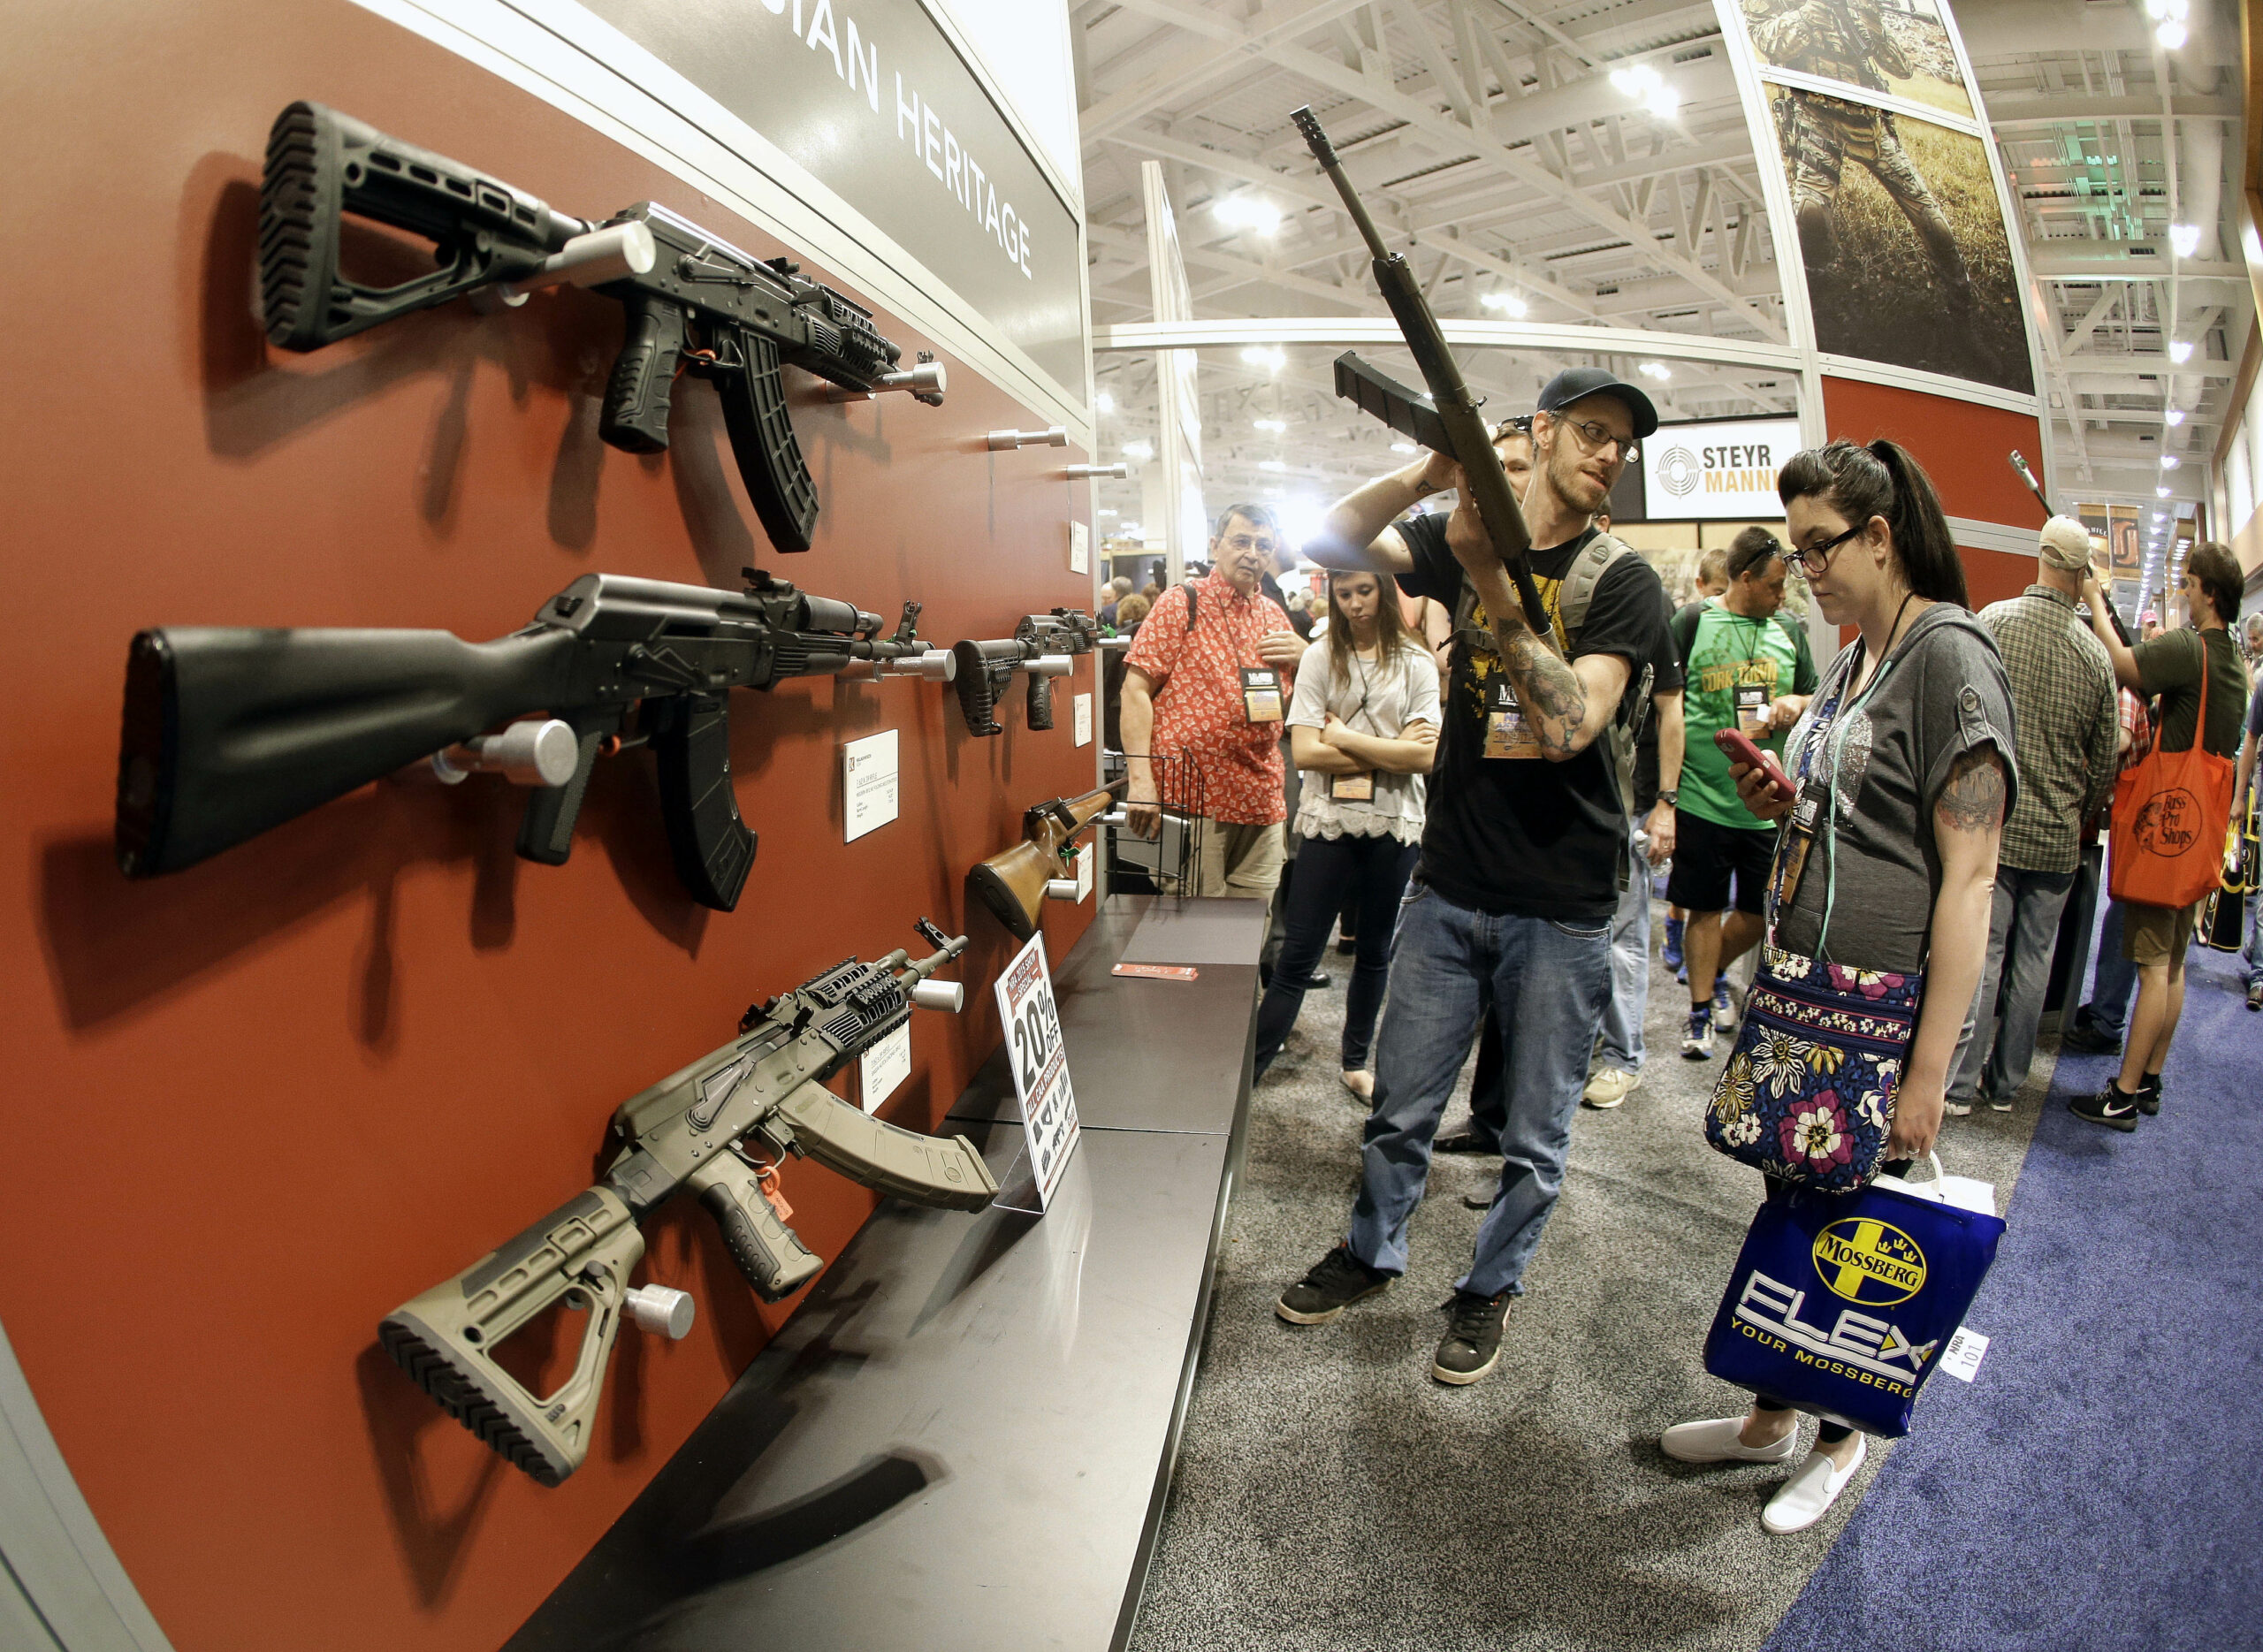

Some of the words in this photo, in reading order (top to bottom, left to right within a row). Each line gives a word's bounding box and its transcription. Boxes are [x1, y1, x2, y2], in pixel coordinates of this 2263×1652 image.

[761, 0, 879, 115] IAN
[895, 70, 1032, 281] HERITAGE
[1703, 445, 1772, 469] STEYR
[1702, 670, 1734, 693] CORK
[2163, 795, 2187, 811] Bass
[2161, 811, 2180, 827] Pro
[2160, 826, 2192, 849] Shops
[1014, 980, 1055, 1095] 20%
[1046, 1022, 1059, 1054] OFF
[1026, 1098, 1039, 1118] ALL
[1043, 1047, 1065, 1089] PRODUCTS
[1819, 1237, 1920, 1288] MOSSBERG
[1740, 1269, 1939, 1371] FLEX
[1731, 1316, 1787, 1353] YOUR
[1794, 1350, 1913, 1398] MOSSBERG
[1948, 1335, 1965, 1356] NRA
[1961, 1344, 1983, 1367] 101
